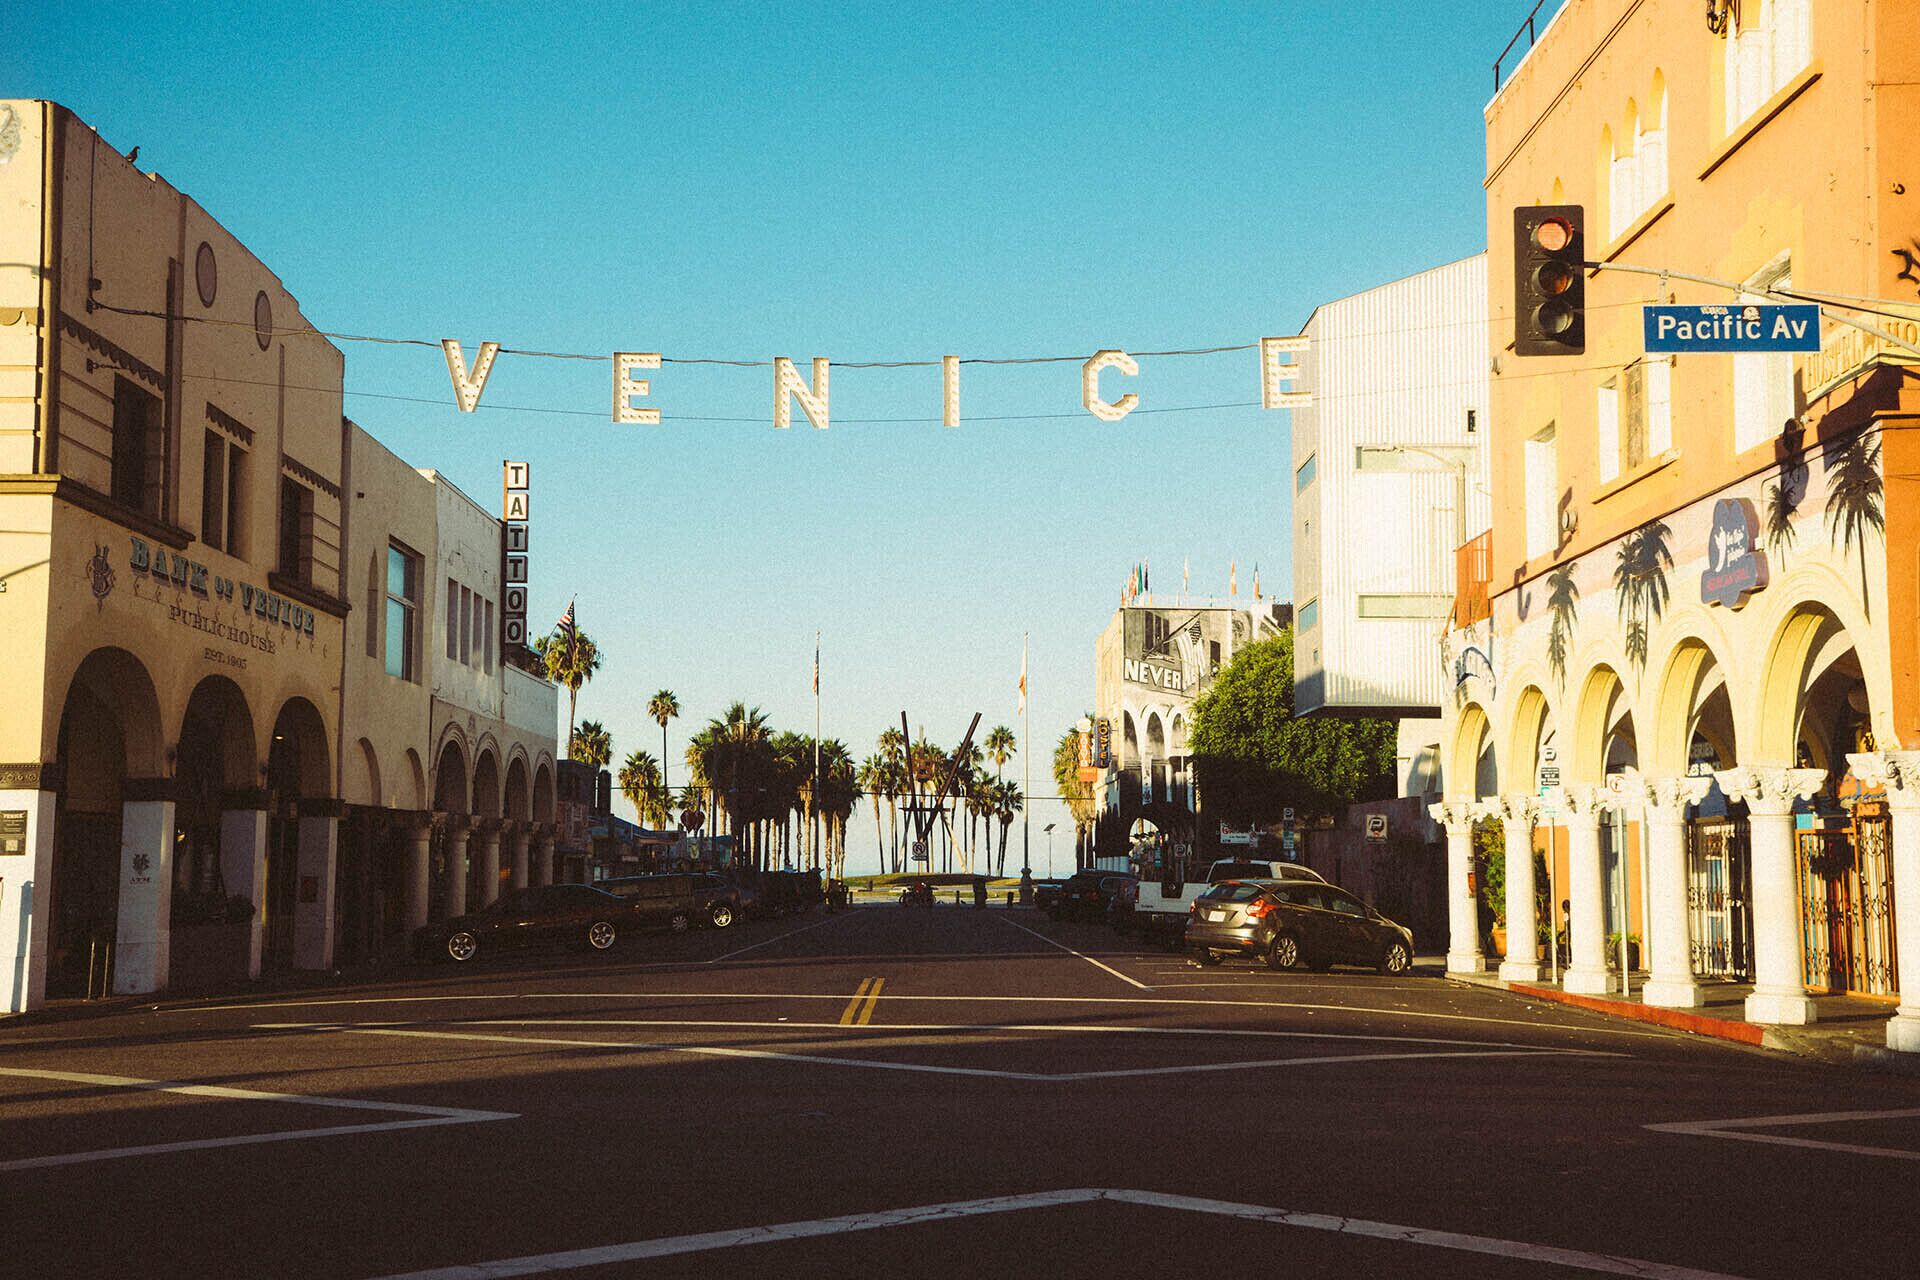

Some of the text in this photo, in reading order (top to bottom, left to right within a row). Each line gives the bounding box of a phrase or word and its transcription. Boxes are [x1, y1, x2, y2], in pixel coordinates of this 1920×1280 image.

[1657, 314, 1808, 340] Pacific Av
[441, 335, 1314, 429] VENICE
[507, 465, 525, 638] TATTOO
[128, 536, 209, 600] BANK
[239, 581, 315, 638] VENICE
[168, 604, 276, 655] PUBLIC HOUSE
[1124, 658, 1182, 691] NEVER
[1099, 719, 1109, 768] HOSTEL
